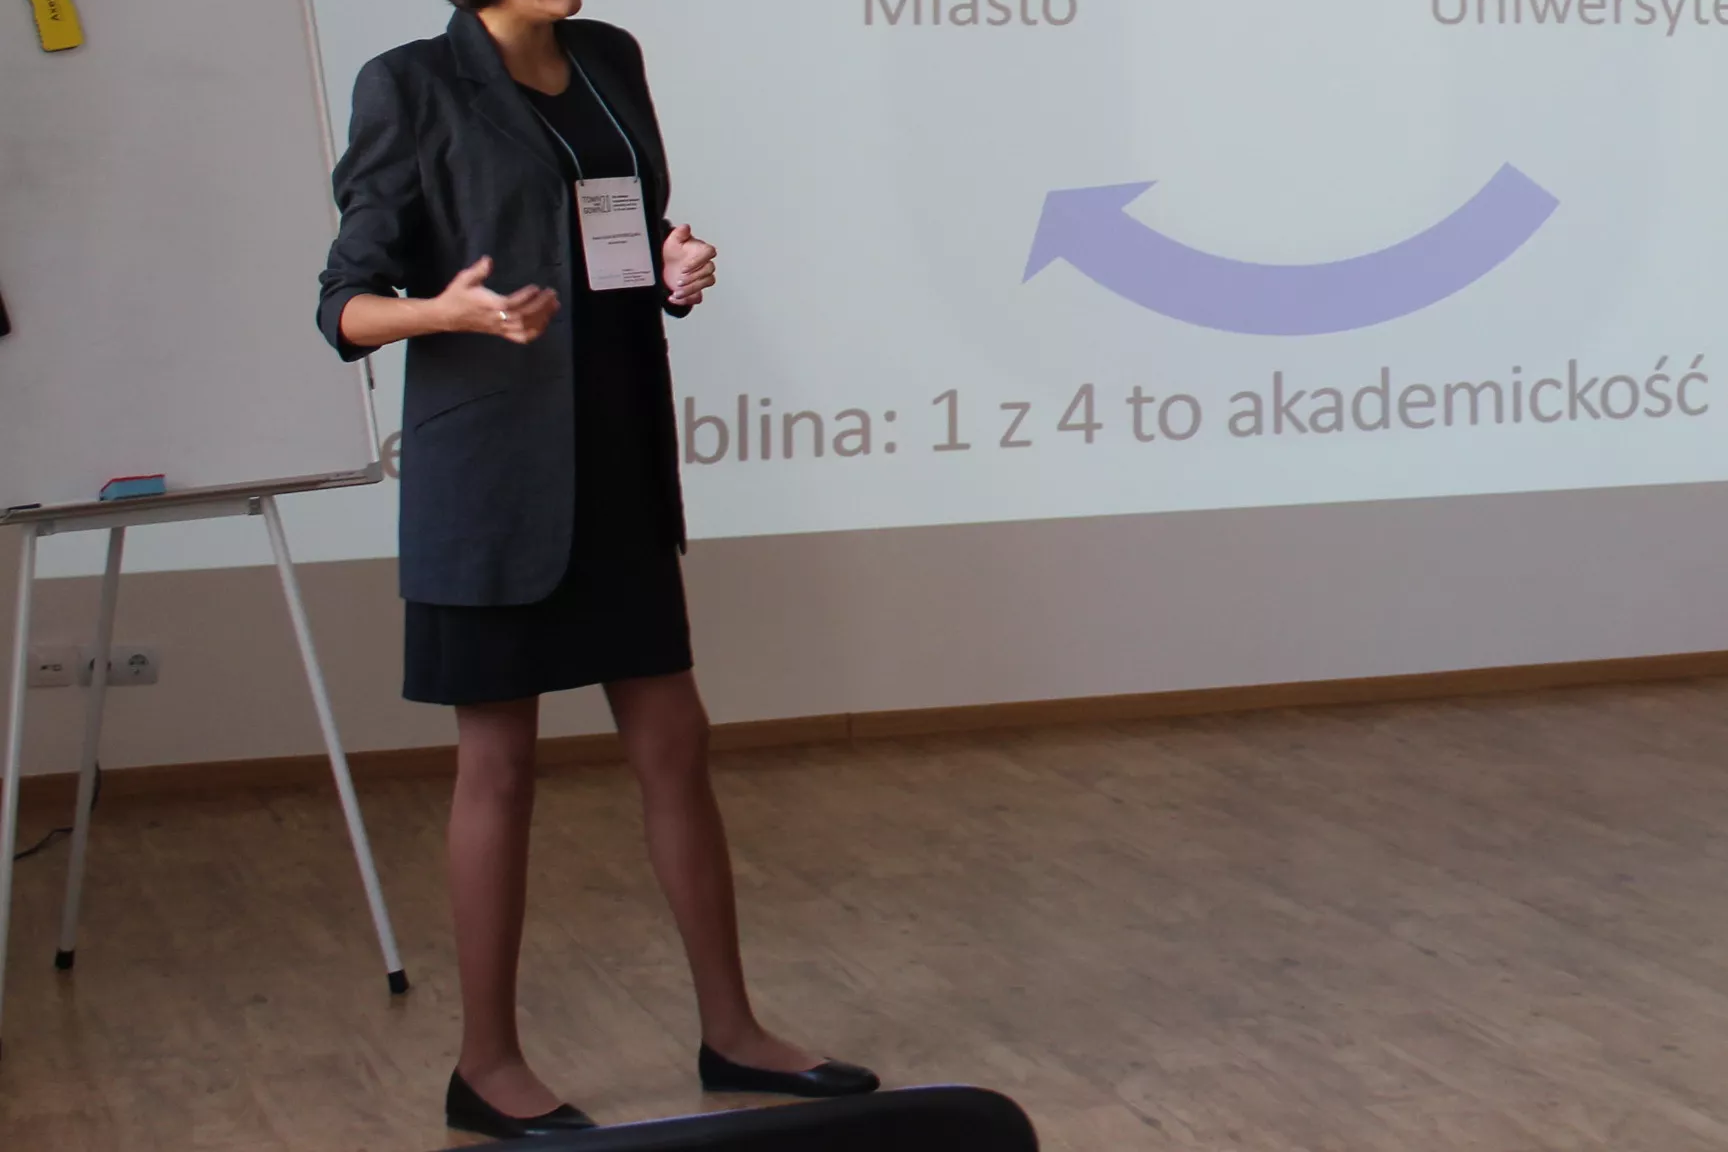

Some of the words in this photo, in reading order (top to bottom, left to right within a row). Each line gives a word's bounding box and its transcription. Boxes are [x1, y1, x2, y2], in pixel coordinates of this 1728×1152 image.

[684, 393, 897, 464] blina:
[931, 388, 971, 452] 1
[998, 399, 1034, 448] z
[1056, 383, 1103, 445] 4
[1126, 385, 1202, 443] to
[1227, 353, 1709, 438] akademickość
